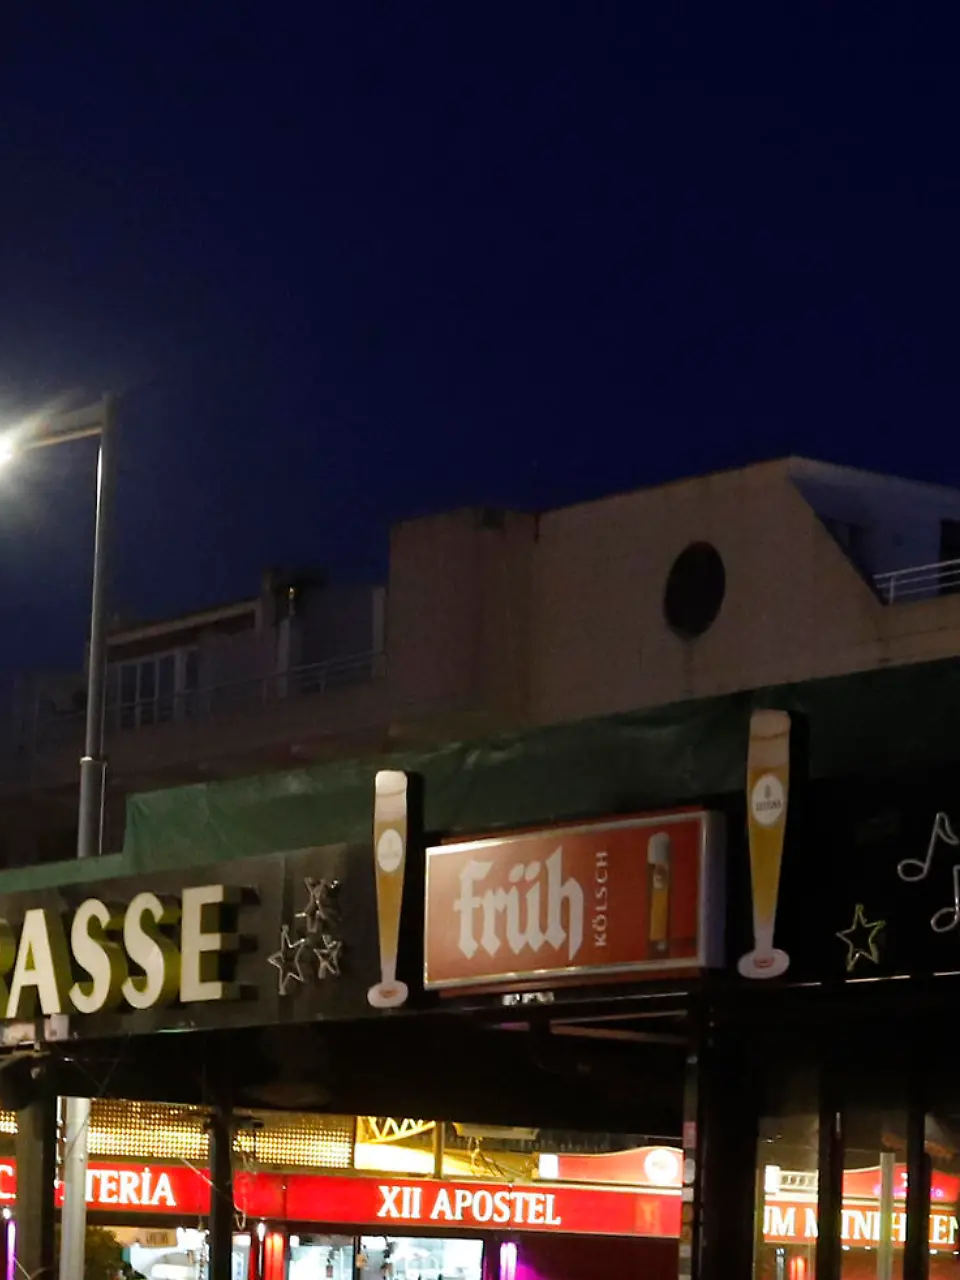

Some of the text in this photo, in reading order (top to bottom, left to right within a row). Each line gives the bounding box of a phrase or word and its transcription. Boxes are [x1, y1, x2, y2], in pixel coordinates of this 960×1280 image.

[453, 846, 584, 960] früh
[592, 851, 609, 948] KÖLSCH
[377, 1185, 562, 1225] XII APOSTEL
